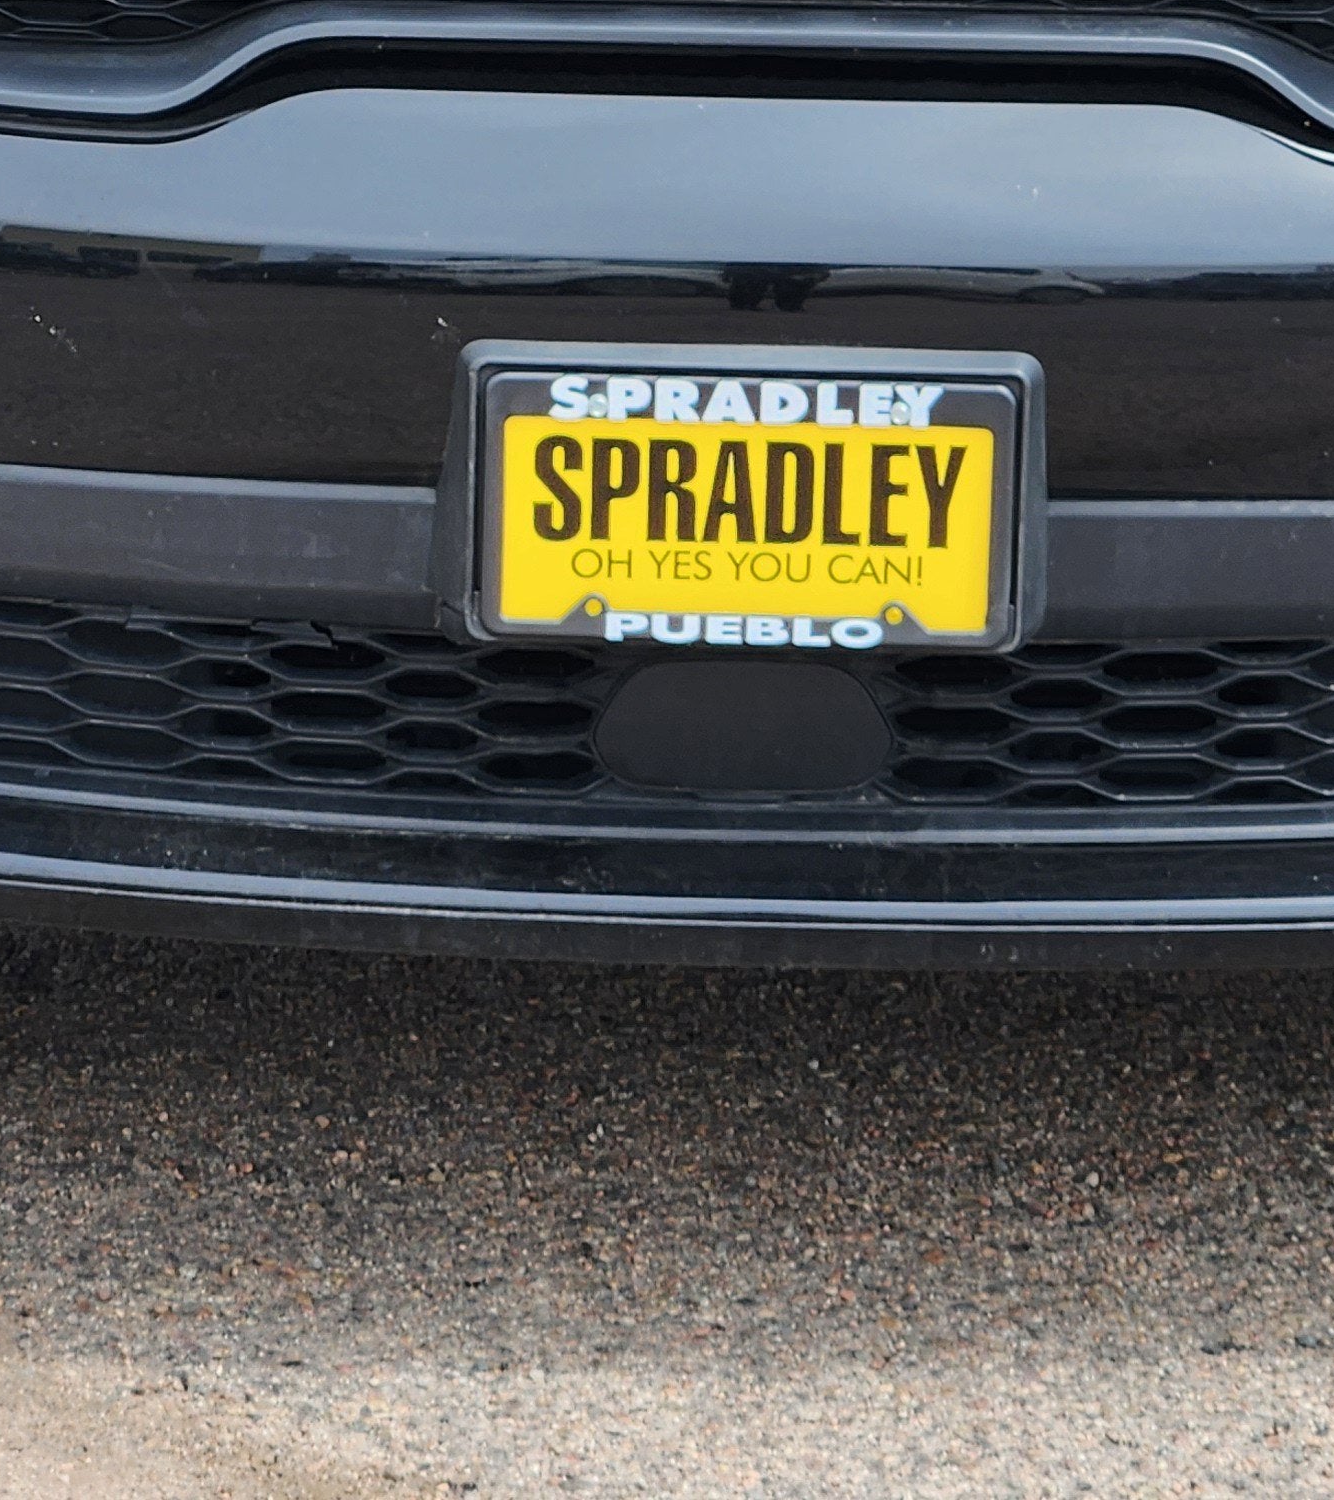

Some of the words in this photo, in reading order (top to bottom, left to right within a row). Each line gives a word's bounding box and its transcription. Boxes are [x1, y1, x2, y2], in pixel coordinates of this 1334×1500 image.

[549, 374, 944, 427] SPRADLEY
[532, 434, 968, 549] SPRADLEY
[570, 547, 633, 579] OH
[648, 549, 712, 581] YES
[727, 550, 812, 583] YOU
[827, 553, 923, 587] CAN!
[603, 610, 884, 649] PUEBLO
